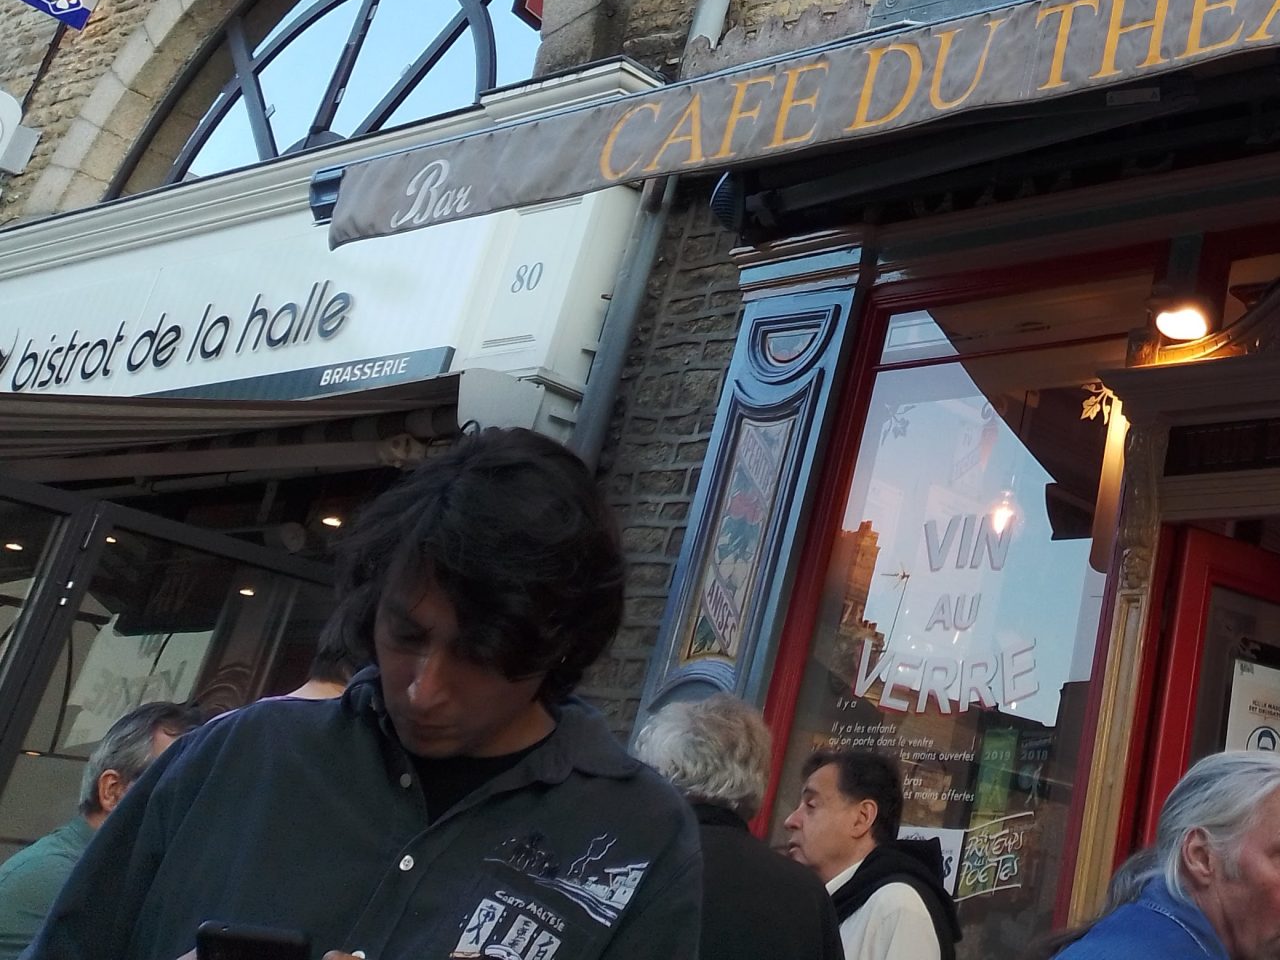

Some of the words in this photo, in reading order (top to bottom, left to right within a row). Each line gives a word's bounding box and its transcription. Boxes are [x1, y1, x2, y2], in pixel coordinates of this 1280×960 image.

[600, 61, 829, 182] CAFE
[844, 18, 1004, 133] DU
[390, 158, 471, 229] Bar
[510, 261, 544, 294] 80
[12, 320, 127, 392] bistrot
[126, 312, 182, 373] de
[186, 303, 230, 363] la
[236, 279, 353, 354] halle
[318, 356, 409, 387] BRASSERIE
[923, 513, 1019, 572] VIN
[925, 593, 981, 632] AU
[853, 636, 1040, 715] VERRE
[853, 735, 875, 748] porte
[877, 736, 896, 747] dans
[908, 737, 934, 748] ventre
[867, 722, 897, 735] enfants
[912, 750, 936, 761] mains
[938, 749, 975, 761] ouvertes
[903, 774, 923, 786] bras
[914, 789, 938, 801] mains
[941, 789, 975, 802] offertes
